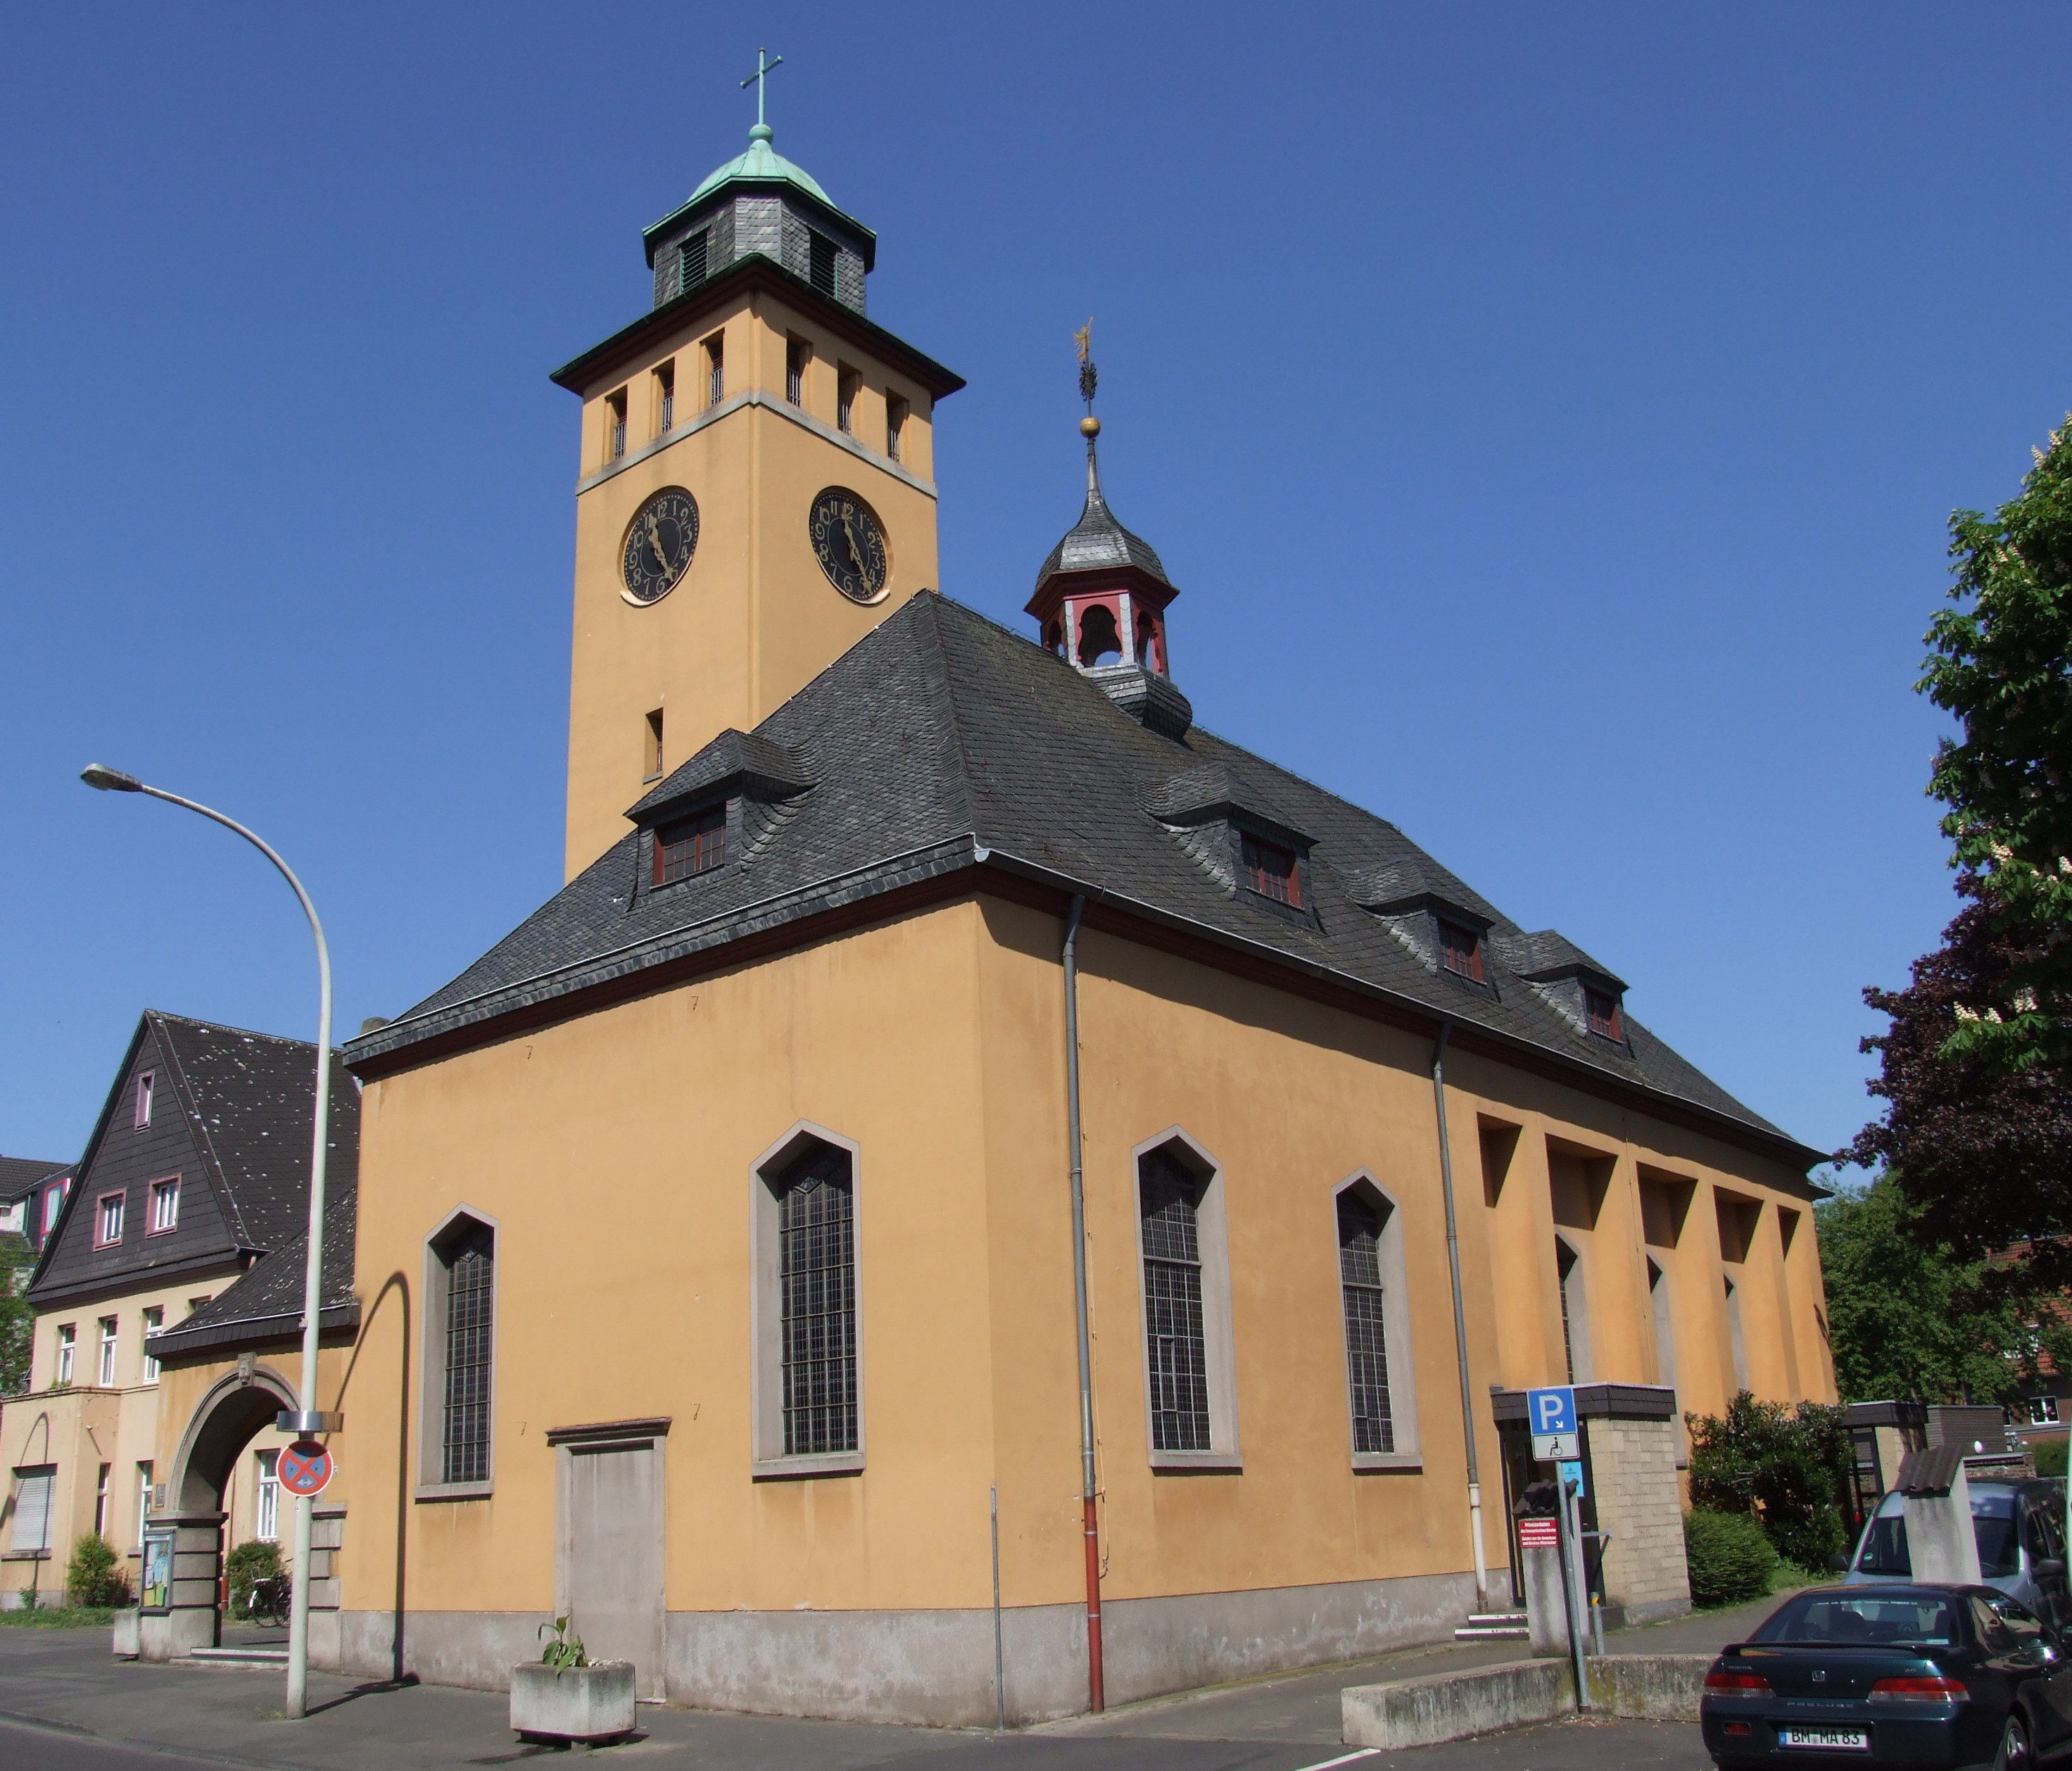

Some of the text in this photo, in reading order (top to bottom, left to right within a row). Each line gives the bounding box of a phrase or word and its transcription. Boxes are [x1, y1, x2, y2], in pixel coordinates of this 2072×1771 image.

[658, 500, 668, 519] 12
[819, 506, 830, 525] 10
[830, 500, 838, 515] 11
[681, 508, 689, 526] 2
[859, 514, 864, 529] 1
[634, 531, 644, 549] 10
[684, 524, 693, 543] 3
[815, 523, 825, 541] 9
[868, 531, 876, 548] 2
[629, 552, 638, 569] 9
[681, 545, 689, 562] 4
[819, 543, 828, 562] 8
[872, 552, 880, 569] 3
[633, 568, 641, 586] 8
[830, 563, 838, 581] 7
[868, 569, 877, 585] 4
[643, 577, 650, 595] 7
[656, 576, 665, 594] 6
[844, 576, 853, 593] 6
[1539, 1394, 1563, 1430] P
[1792, 1729, 1859, 1745] BM MA 83
